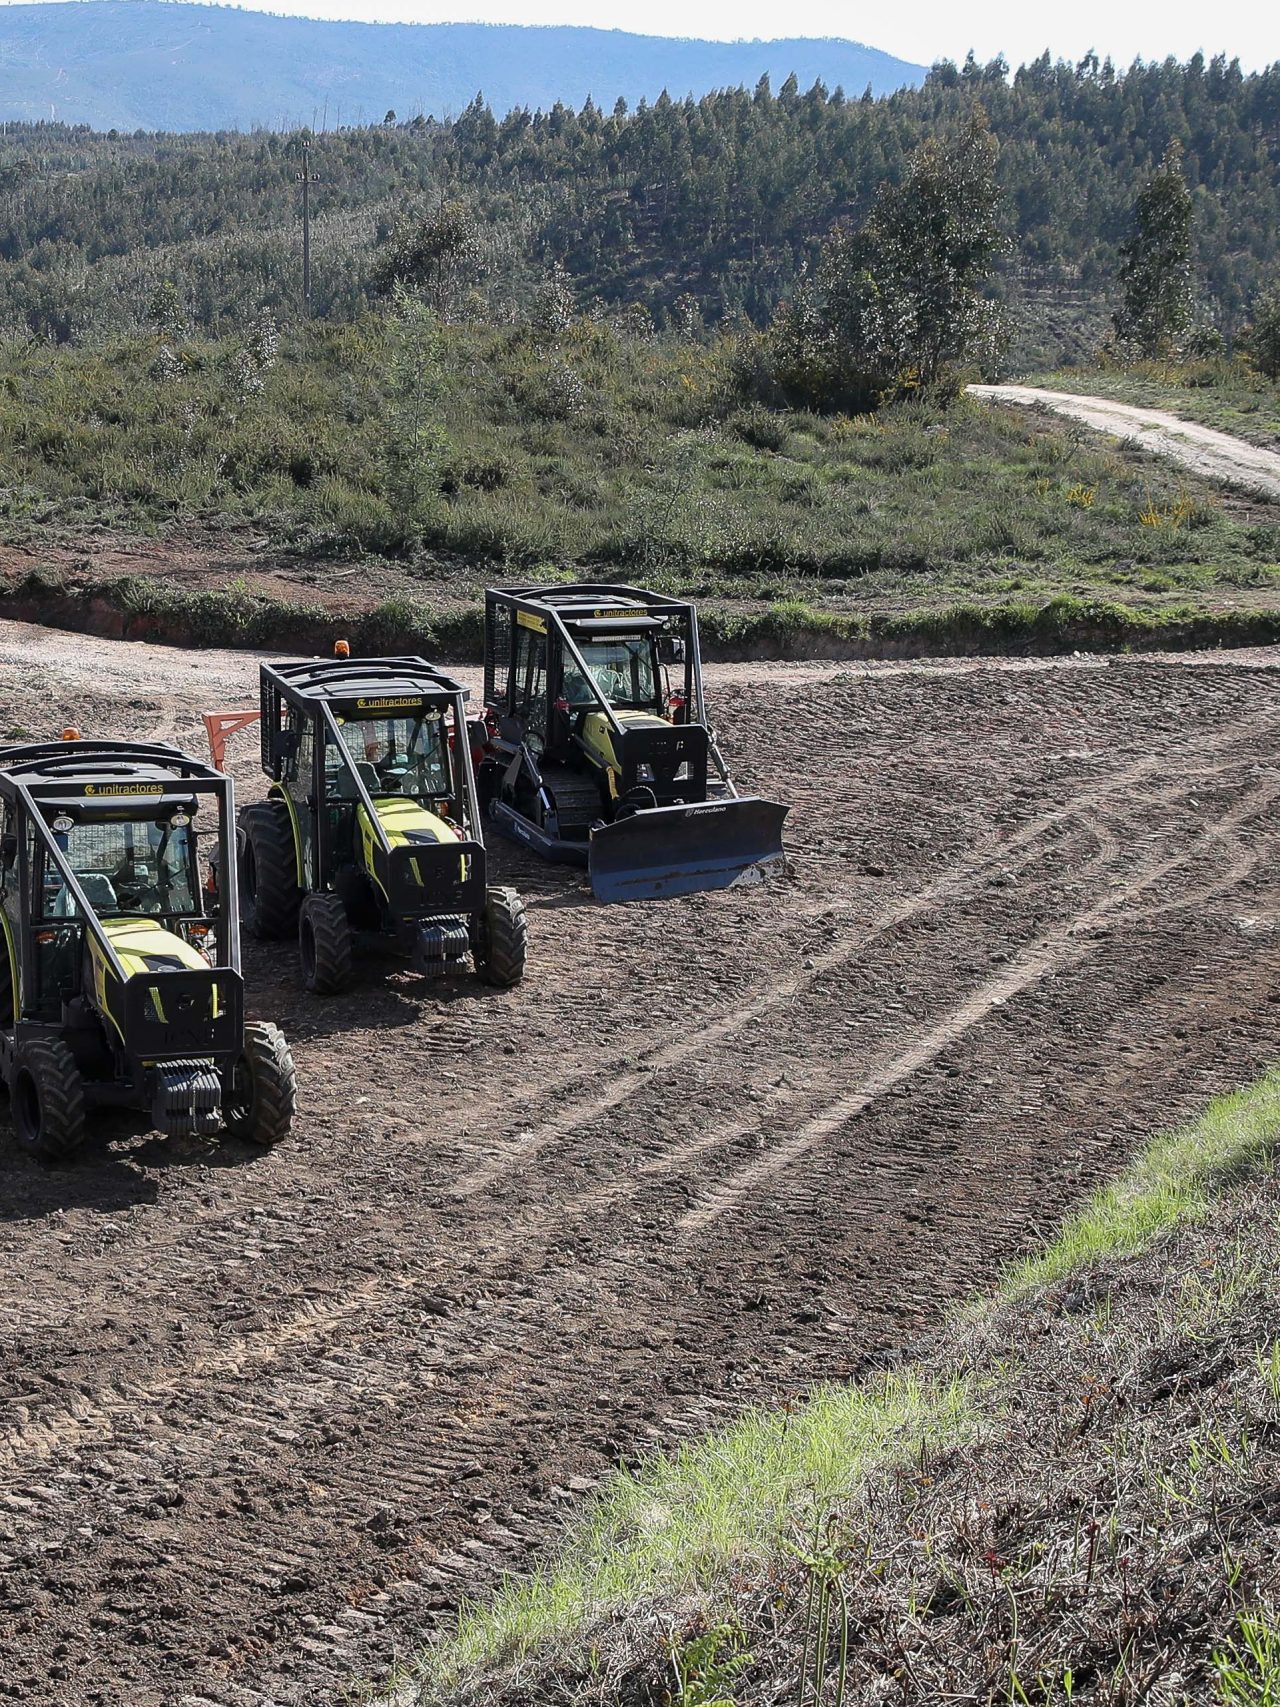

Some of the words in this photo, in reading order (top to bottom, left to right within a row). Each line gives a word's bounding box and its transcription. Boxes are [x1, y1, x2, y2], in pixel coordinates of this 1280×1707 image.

[603, 609, 648, 617] unitractores
[368, 697, 422, 707] unitractores
[99, 784, 164, 795] unitractores
